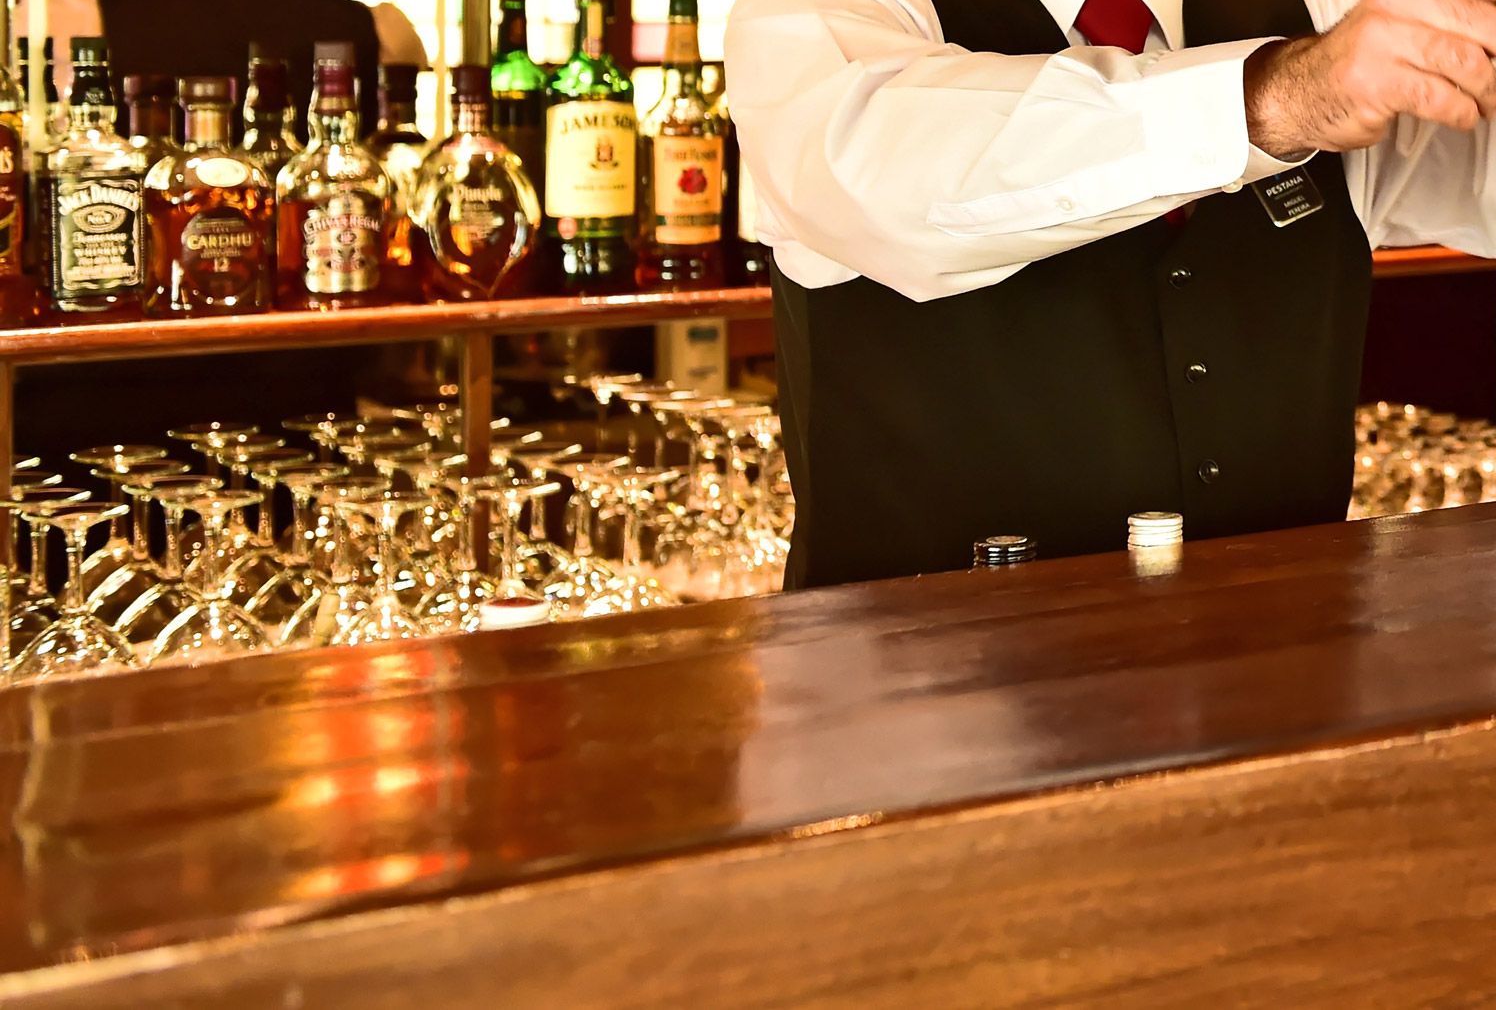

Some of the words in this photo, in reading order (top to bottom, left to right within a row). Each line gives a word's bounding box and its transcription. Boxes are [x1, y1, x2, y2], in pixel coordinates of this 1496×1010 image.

[562, 113, 635, 135] JAMESON
[1265, 175, 1304, 198] PESTANA
[186, 233, 253, 251] CARDHU
[213, 257, 230, 273] 12
